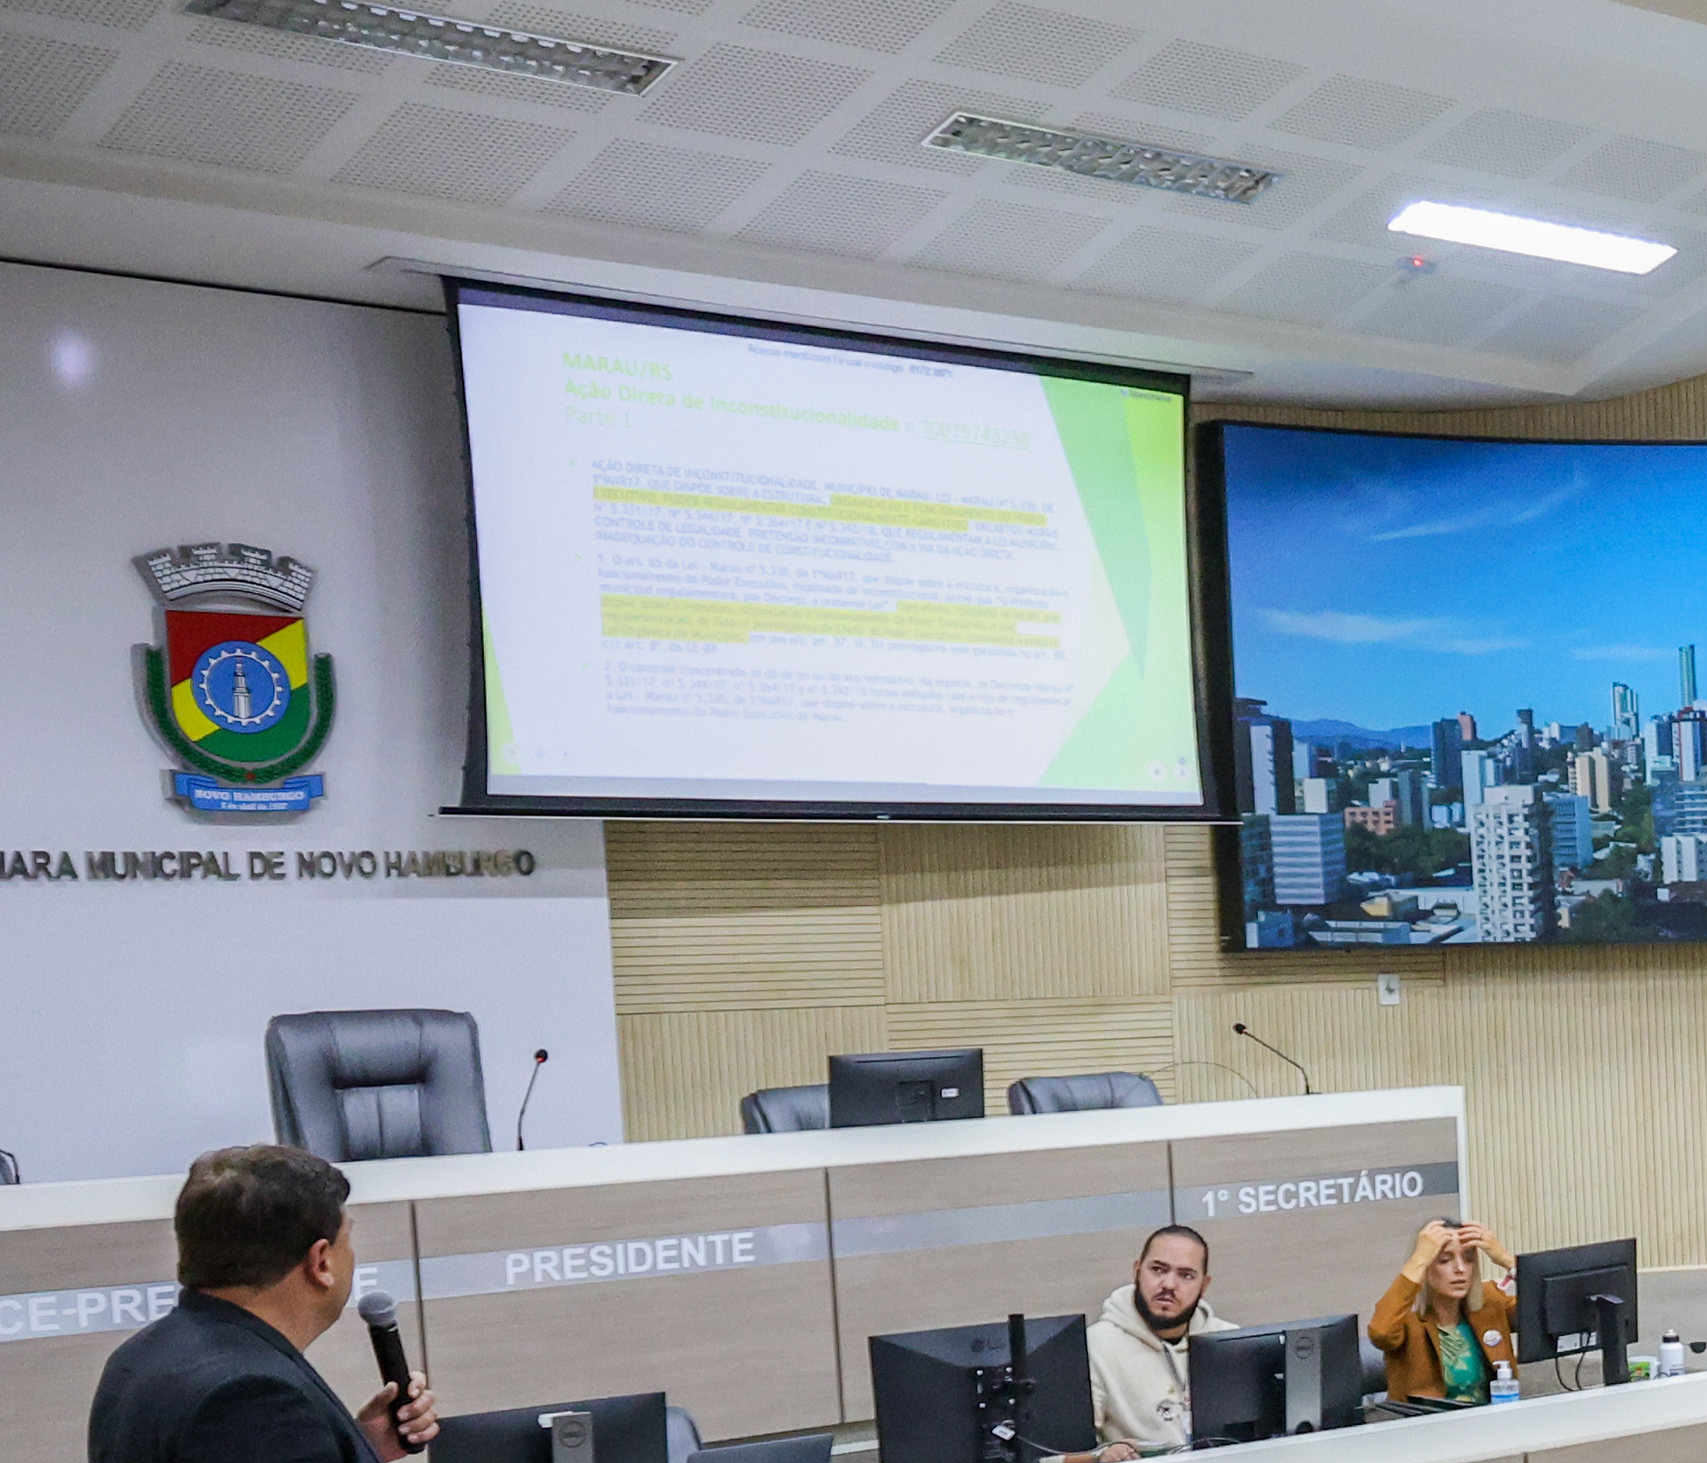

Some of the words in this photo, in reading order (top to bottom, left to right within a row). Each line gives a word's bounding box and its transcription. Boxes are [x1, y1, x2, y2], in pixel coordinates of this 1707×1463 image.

[562, 351, 672, 380] MARAU/RS
[564, 377, 612, 401] Ação
[618, 383, 675, 408] Direta
[682, 390, 704, 411] de
[0, 851, 78, 881] ARA
[85, 851, 241, 881] MUNICIPAL
[249, 851, 287, 881] DE
[297, 850, 377, 881] NOVO
[385, 850, 536, 878] HAMBURGO
[1238, 1170, 1423, 1214] SECRETÁRIO
[505, 1231, 757, 1286] PRESIDENTE
